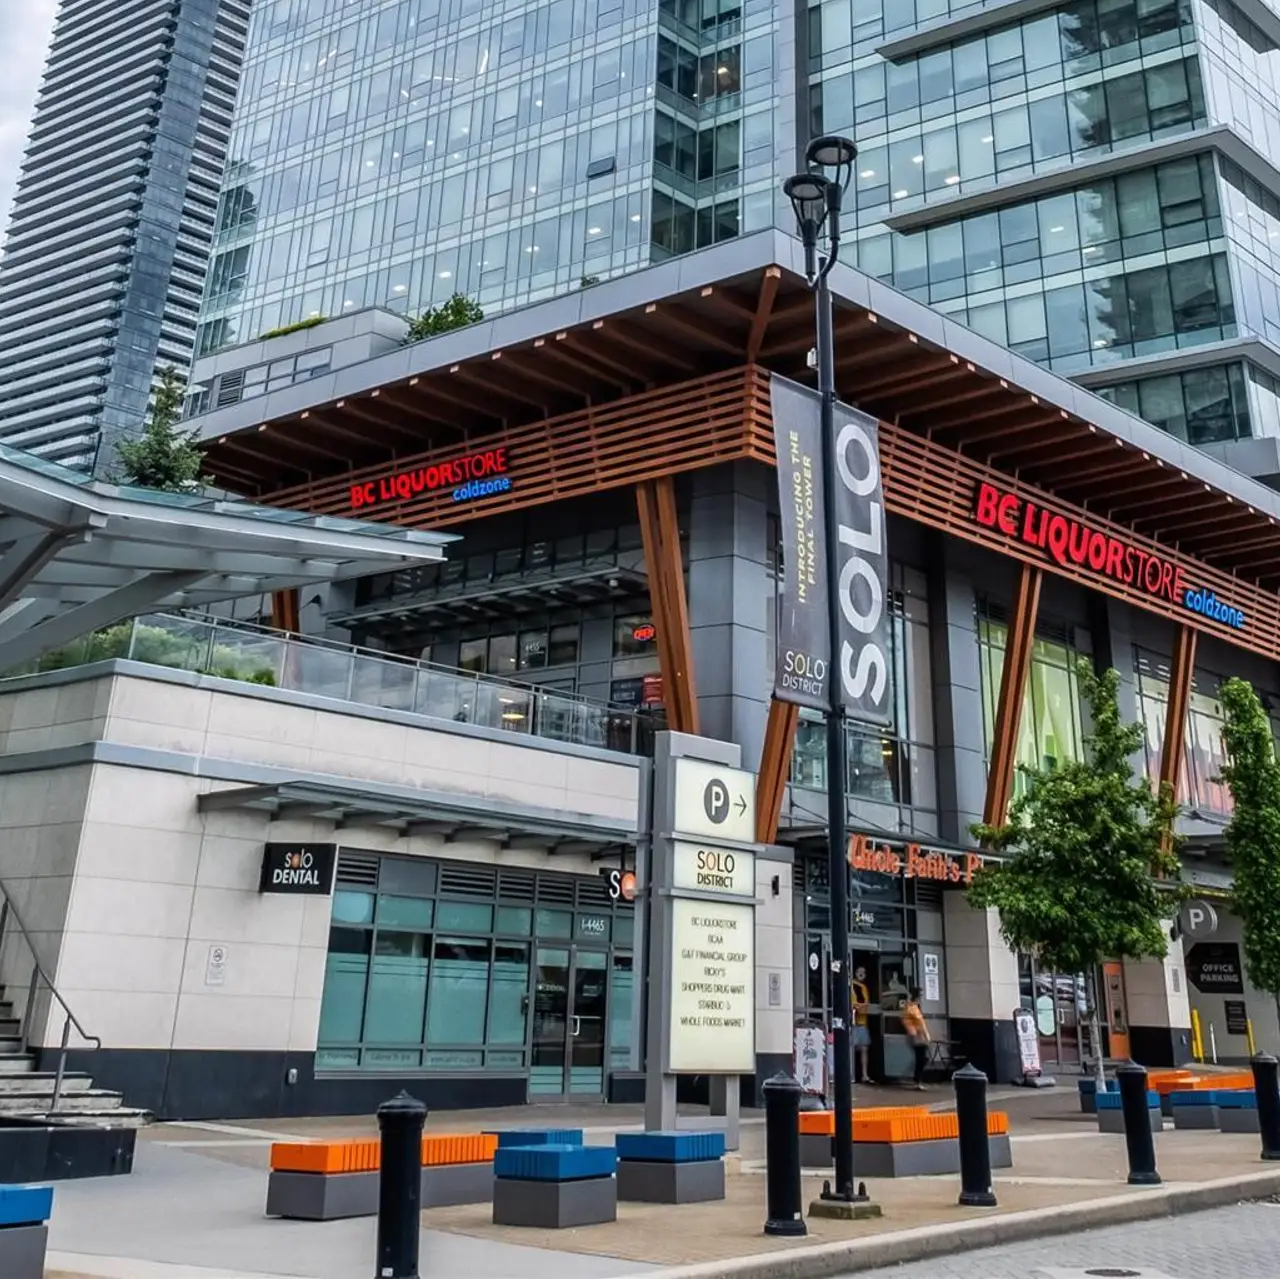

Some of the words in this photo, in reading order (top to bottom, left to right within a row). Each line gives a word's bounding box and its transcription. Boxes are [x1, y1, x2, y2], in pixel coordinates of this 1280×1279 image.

[791, 430, 800, 463] THE
[350, 482, 376, 508] BC
[380, 448, 507, 500] LIQUORSTORE
[452, 477, 511, 502] coldzone
[803, 455, 813, 520] TOWER
[794, 470, 806, 604] INTRODUCING
[977, 483, 1019, 536] BC
[1023, 503, 1186, 603] LIQUORSTORE
[806, 529, 815, 585] FINAL
[836, 424, 886, 706] SOLO
[1184, 587, 1246, 628] coldzone
[784, 650, 825, 680] SOLO
[782, 675, 823, 696] DISTRICT
[711, 785, 724, 816] P
[697, 850, 735, 873] SOLO
[848, 833, 900, 873] Uncle
[905, 842, 960, 882] Fatih's
[272, 869, 320, 884] DENTAL
[697, 873, 733, 888] DISTRICT
[1188, 909, 1204, 930] P
[696, 950, 725, 960] FINANCIAL
[726, 952, 747, 962] GROUP
[1202, 963, 1234, 973] OFFICE
[682, 982, 712, 993] SHOPPERS
[714, 984, 730, 994] DRUG
[730, 984, 745, 994] MART
[1200, 974, 1239, 982] PARKING
[698, 1000, 731, 1010] STARBUCS
[680, 1016, 701, 1026] WHOLE
[703, 1017, 723, 1027] FOODS
[724, 1018, 745, 1028] MARKET
